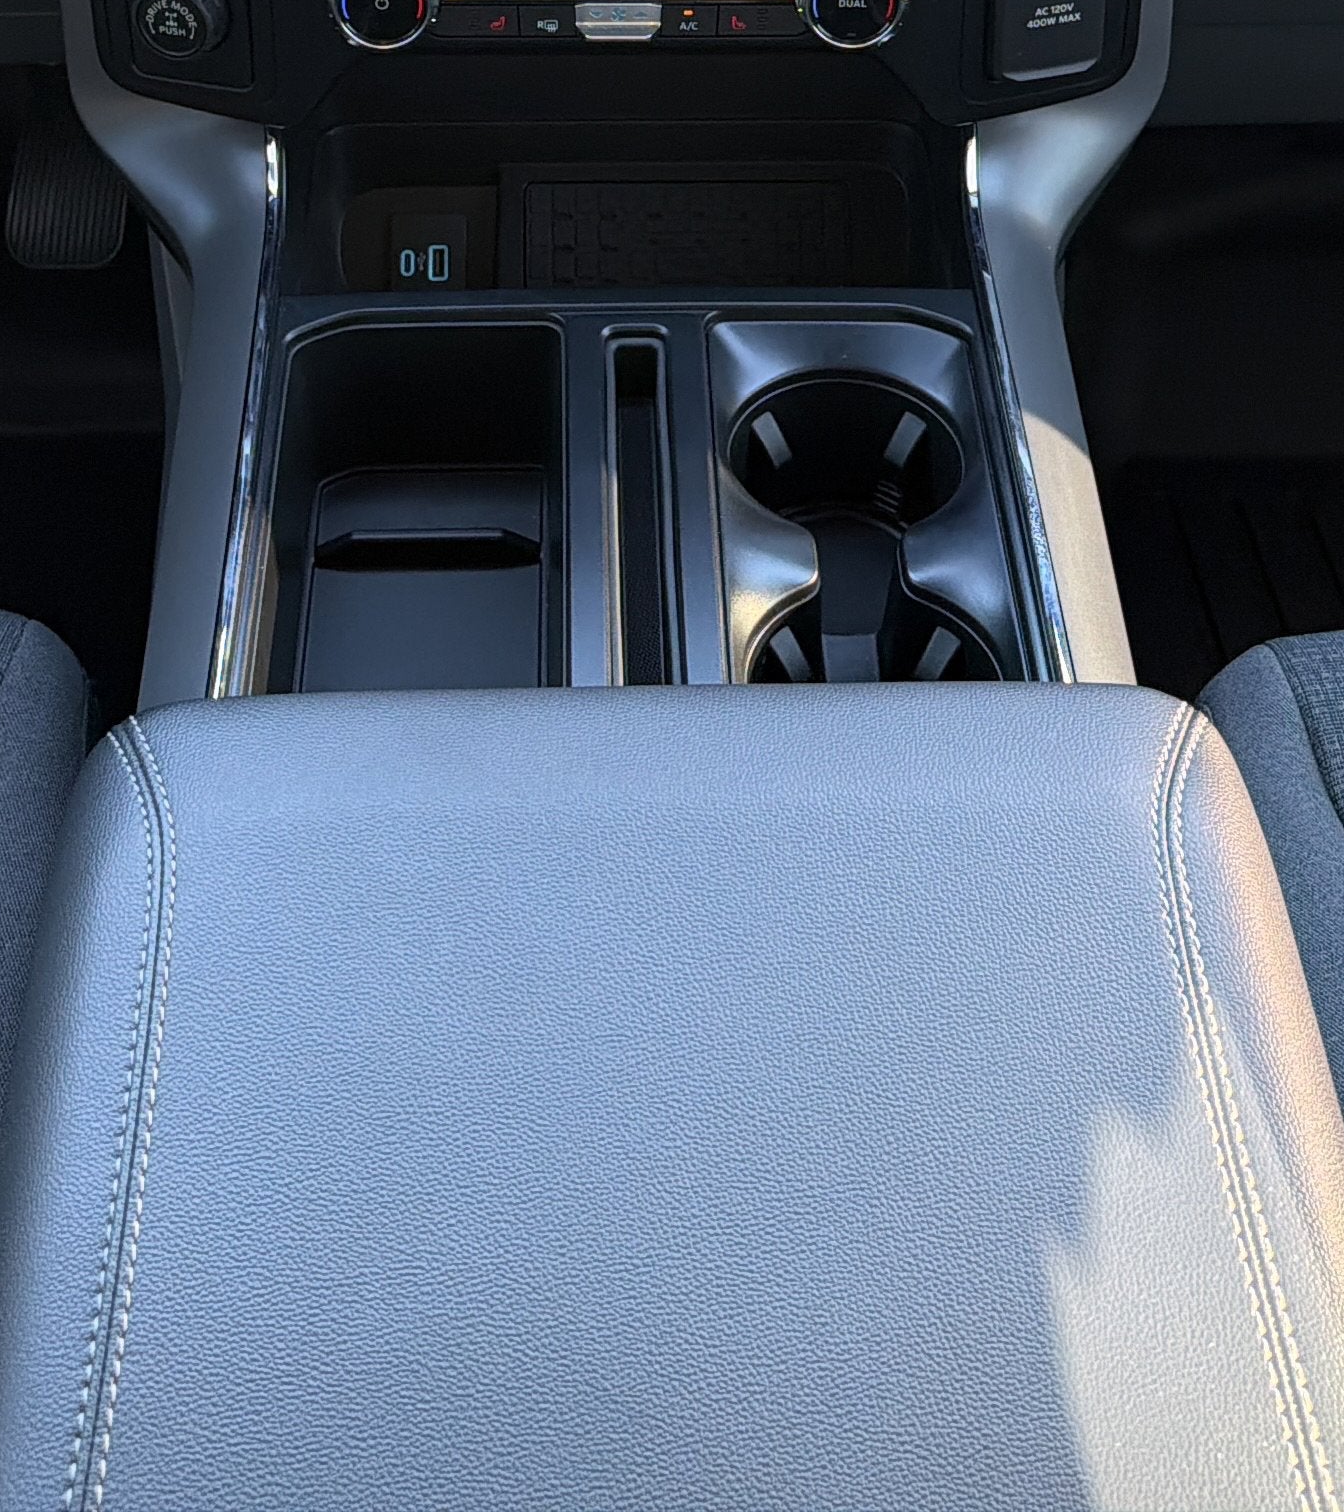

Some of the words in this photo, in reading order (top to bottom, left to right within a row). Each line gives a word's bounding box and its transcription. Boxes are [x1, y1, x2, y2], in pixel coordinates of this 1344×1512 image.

[145, 0, 168, 23] DRIVE
[171, 0, 198, 27] MODE
[1035, 7, 1048, 17] AC
[1050, 2, 1074, 14] 120V
[679, 21, 699, 31] A/C
[1026, 16, 1056, 29] 400W
[1059, 11, 1081, 23] MAX
[158, 25, 186, 36] PUSH
